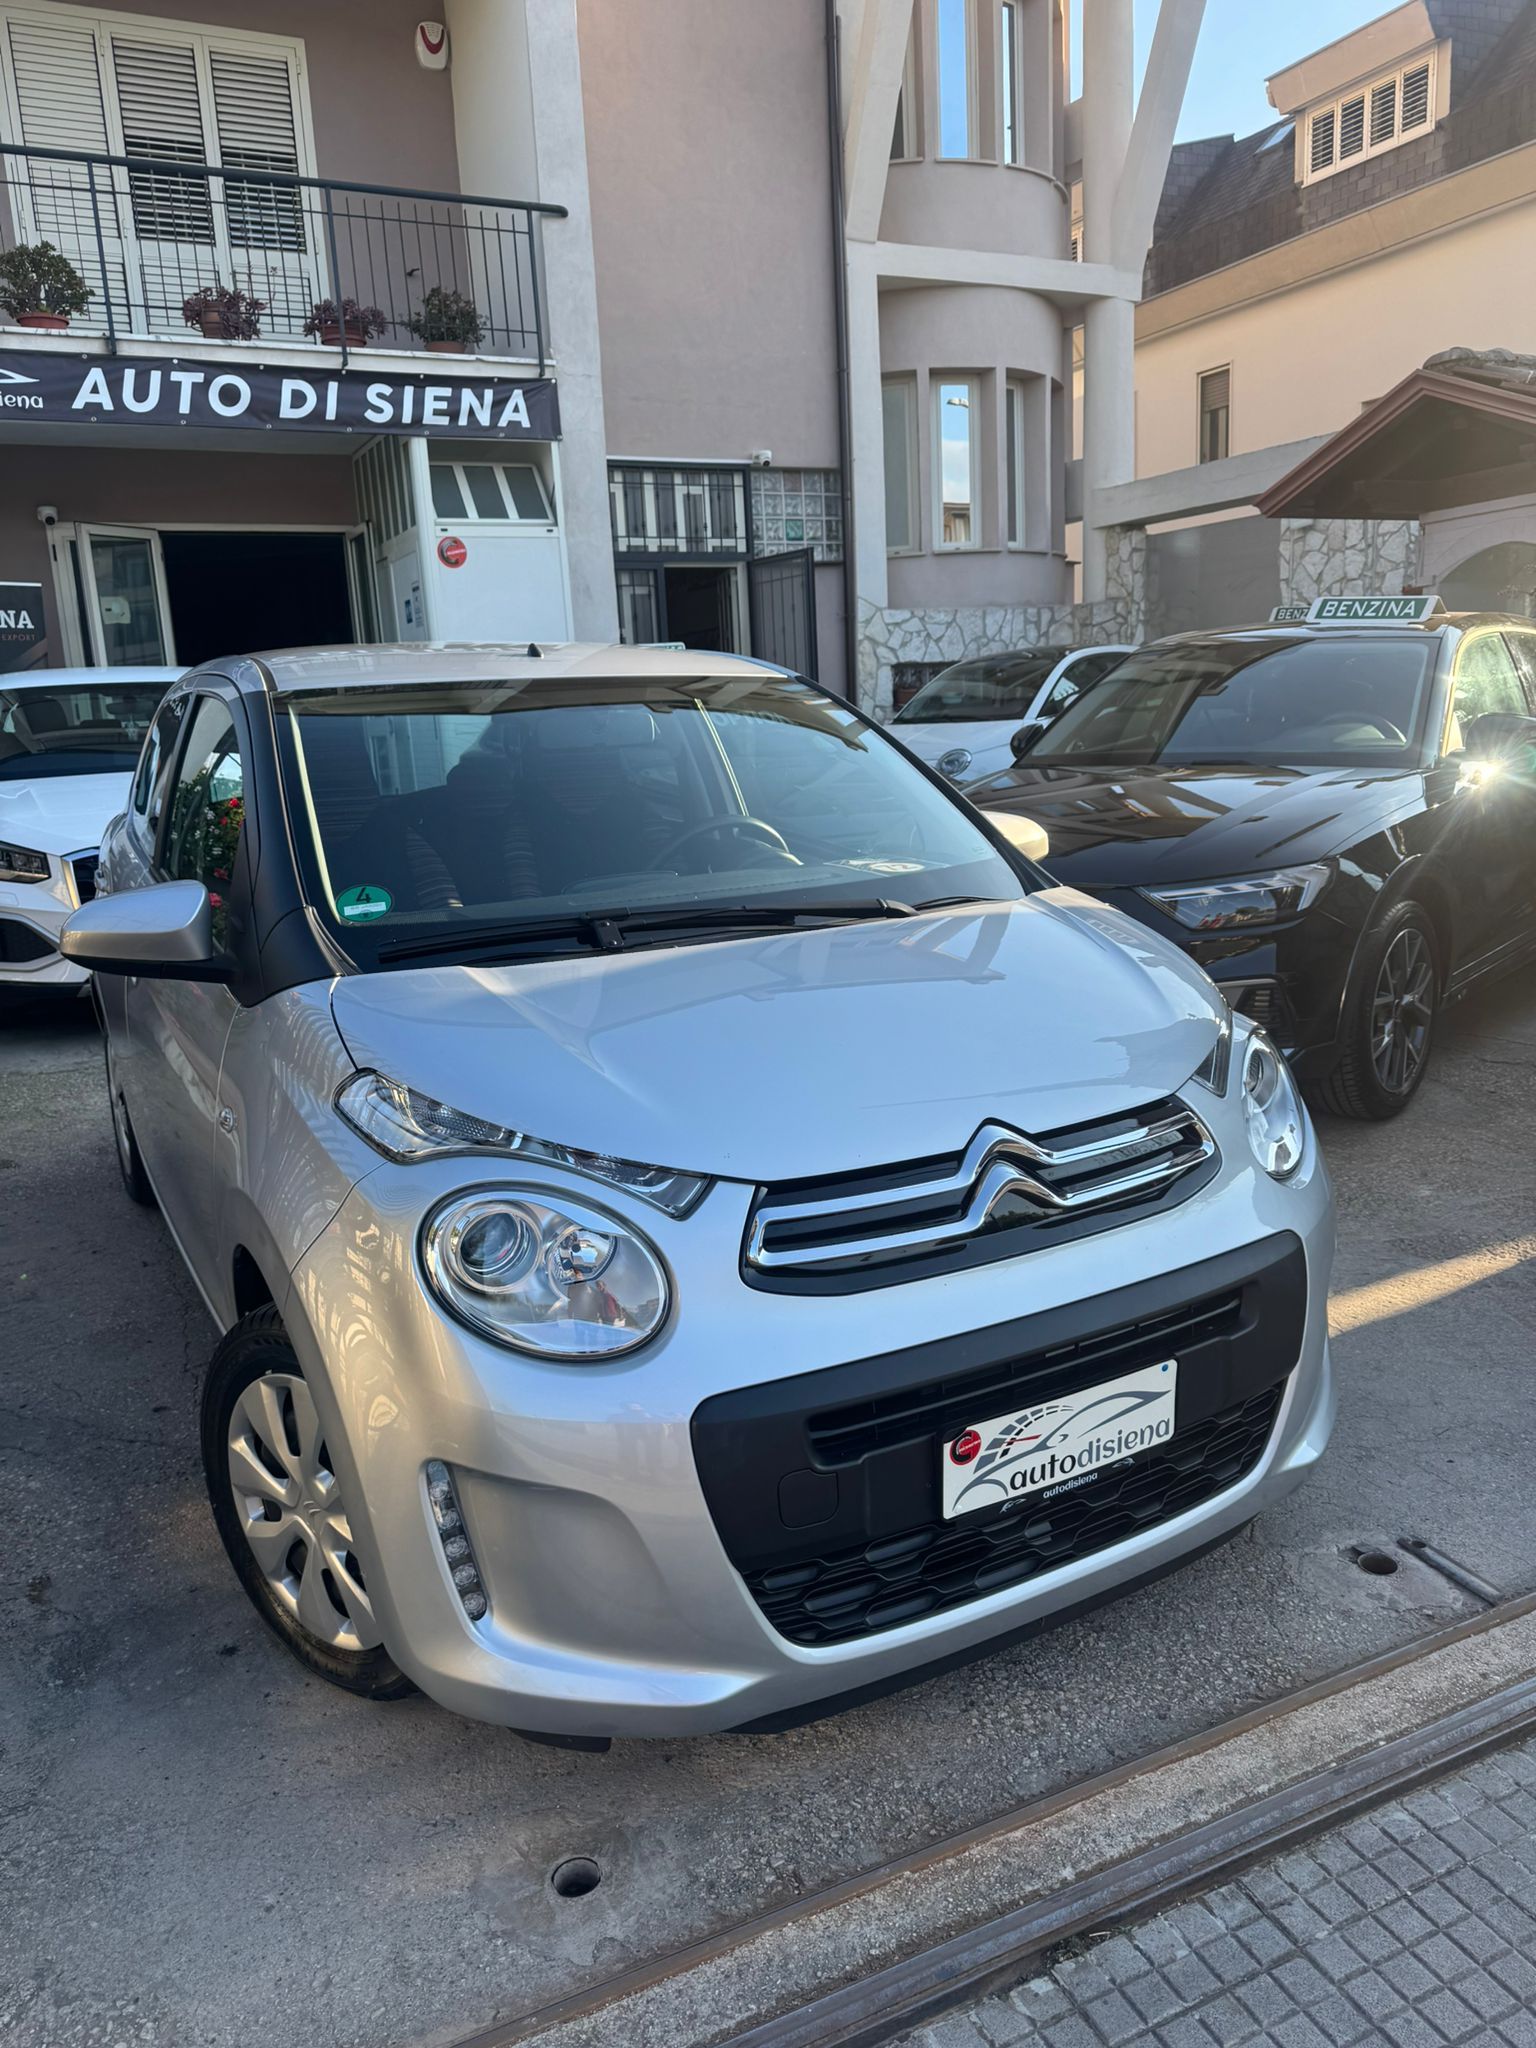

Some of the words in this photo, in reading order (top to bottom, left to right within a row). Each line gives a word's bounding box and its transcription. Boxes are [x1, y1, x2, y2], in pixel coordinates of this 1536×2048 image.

[71, 366, 252, 418] AUTO
[279, 378, 339, 422] DI
[363, 382, 532, 429] SIENA
[1322, 600, 1416, 617] BENZINA
[2, 633, 35, 641] EXPORT
[356, 886, 372, 903] 4
[1010, 1417, 1171, 1491] autodisiena
[1043, 1471, 1098, 1500] autodisiena
